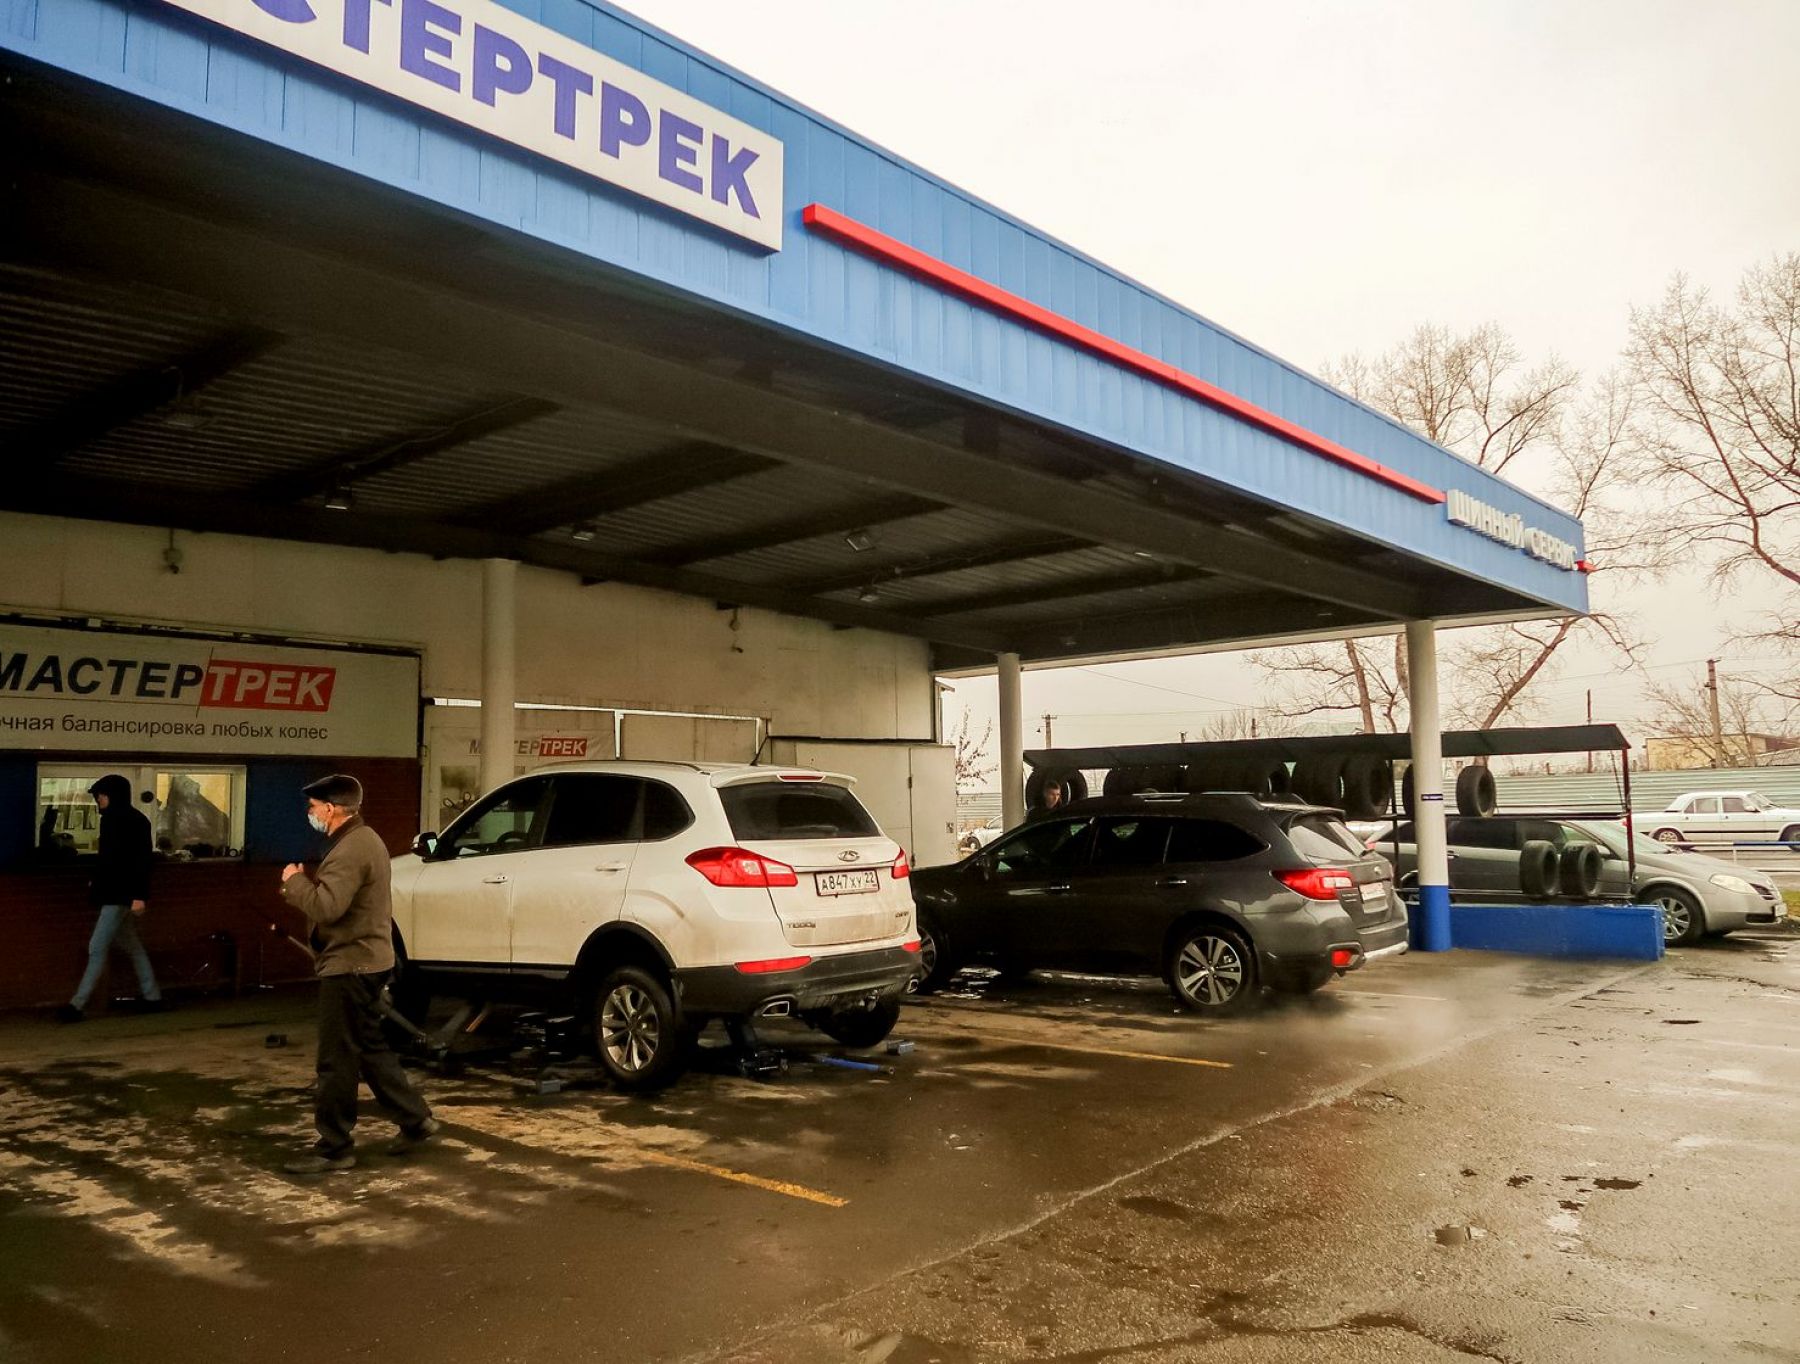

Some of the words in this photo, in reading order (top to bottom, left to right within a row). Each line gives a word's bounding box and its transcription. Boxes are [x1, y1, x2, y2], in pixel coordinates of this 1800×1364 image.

[251, 0, 761, 219] ТЕРТРЕК
[0, 715, 54, 731] чная
[62, 715, 205, 738] балансировка
[211, 722, 273, 739] любых
[279, 726, 328, 740] колес
